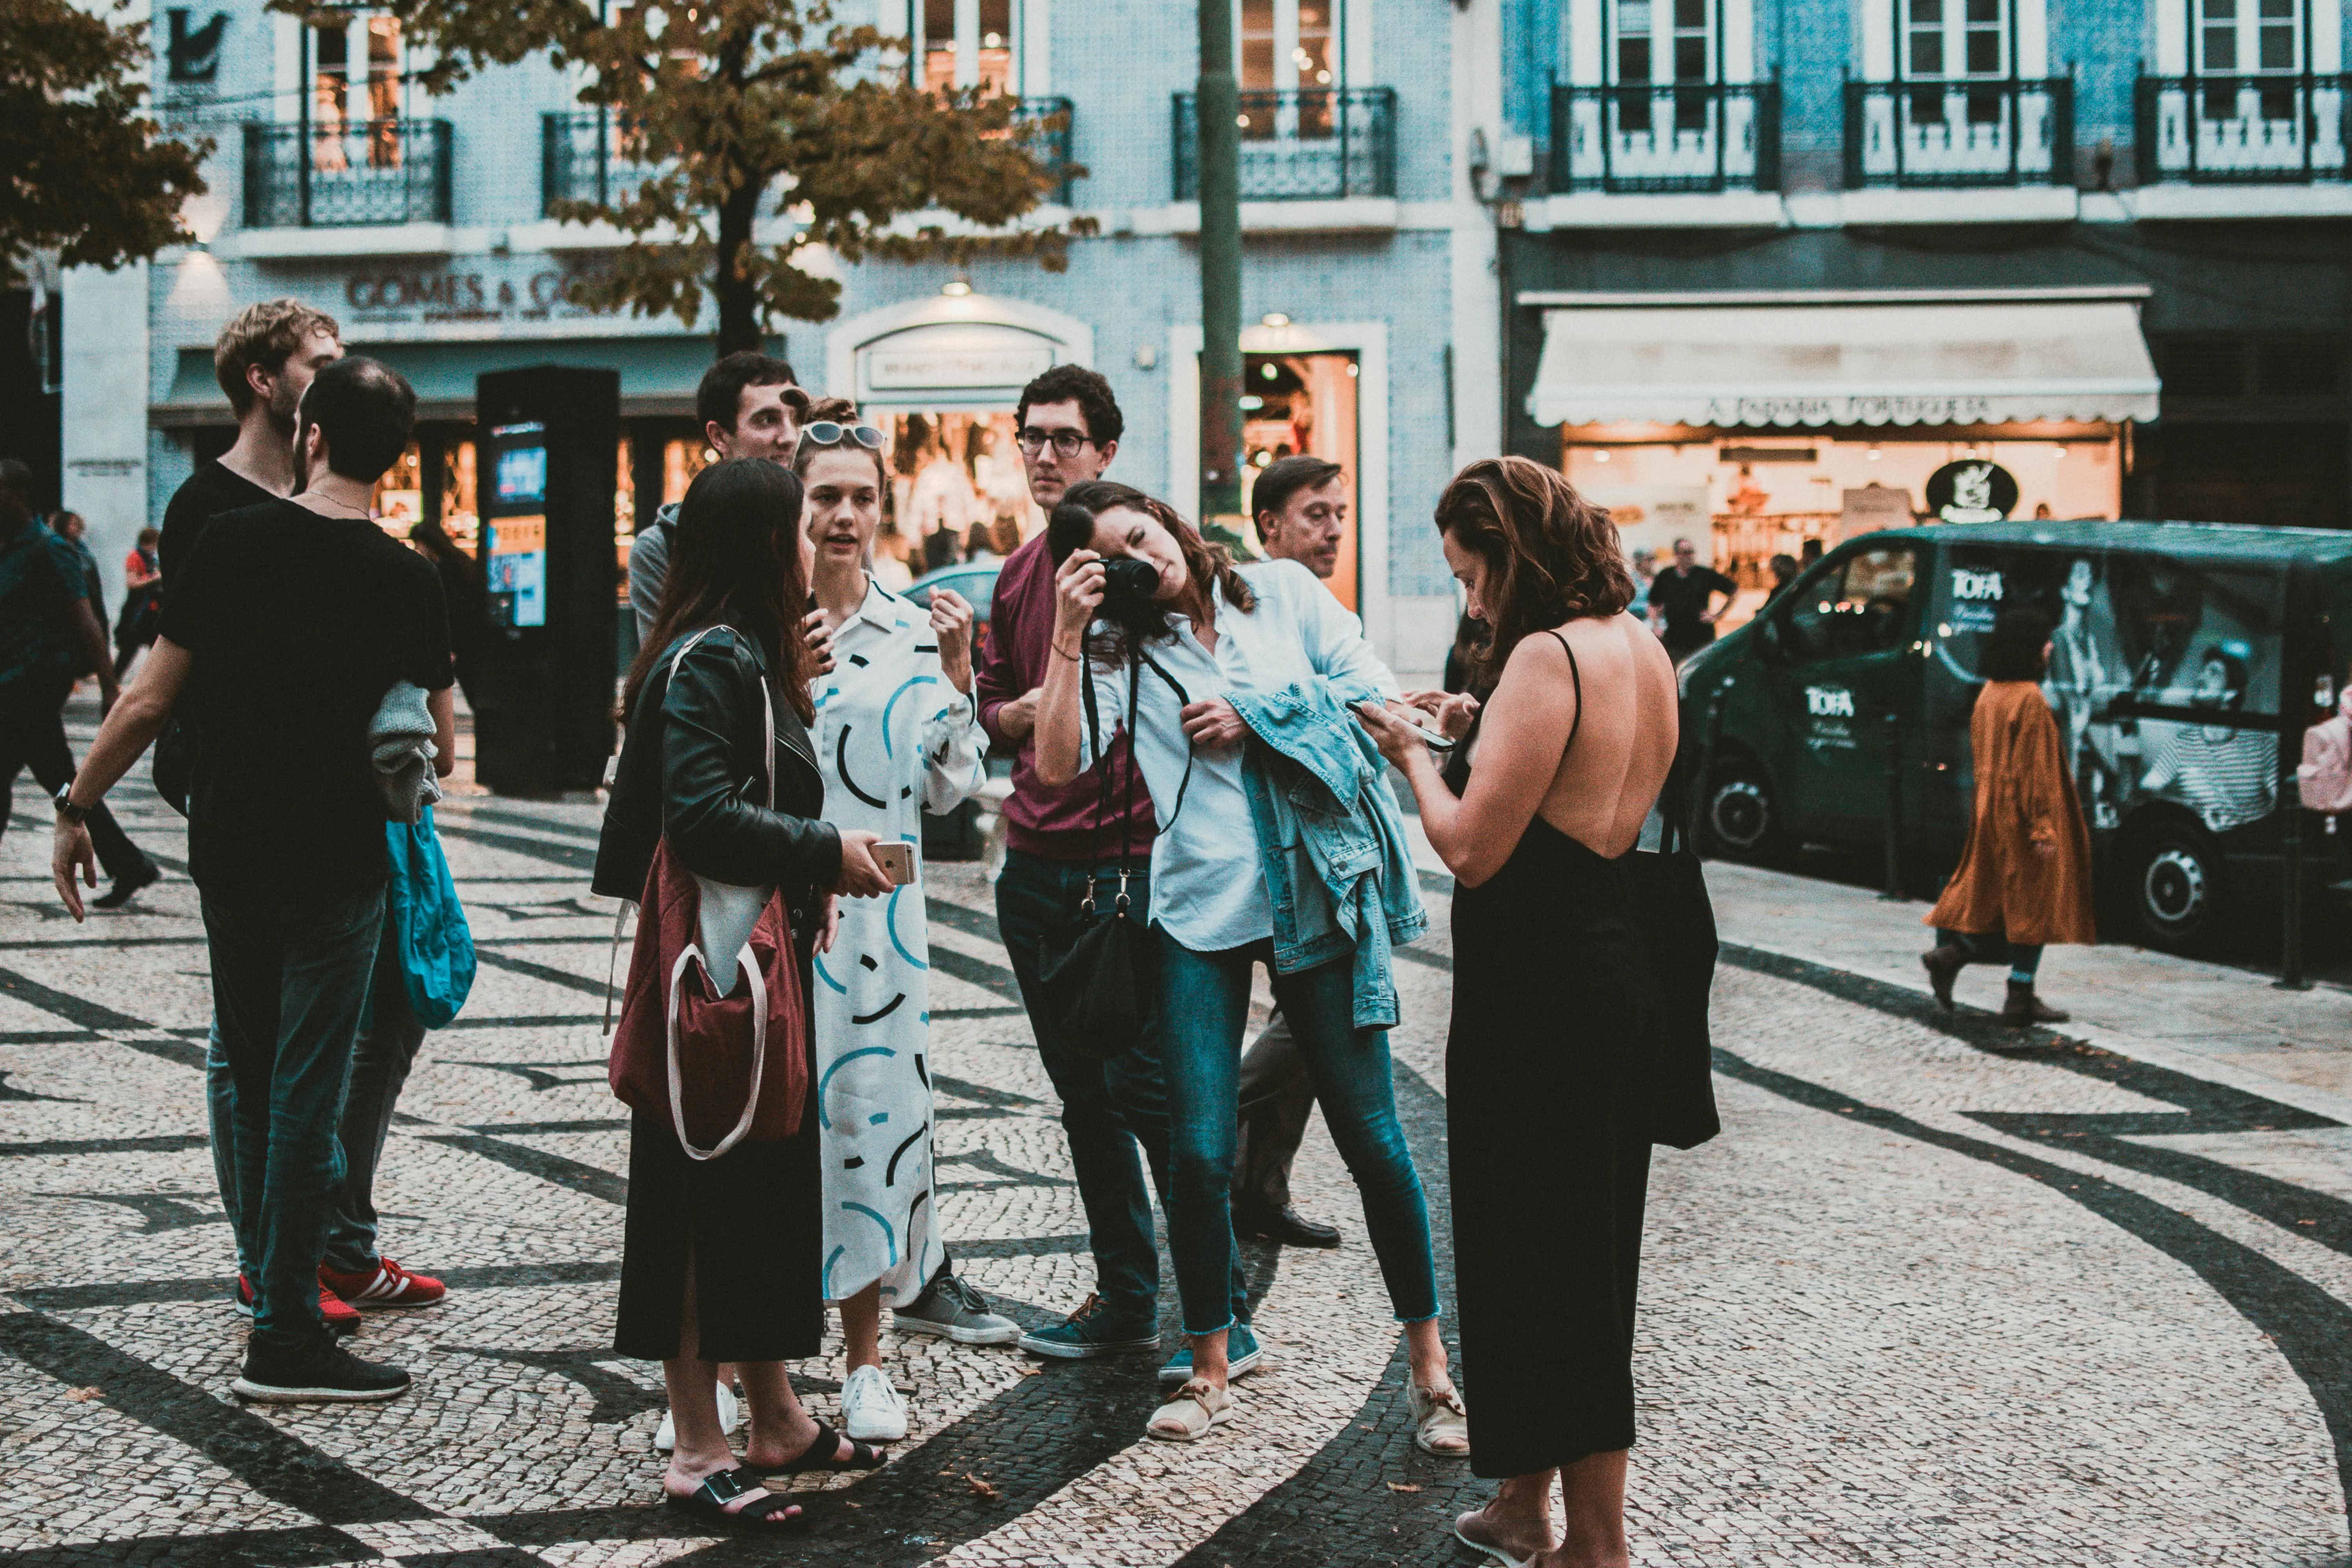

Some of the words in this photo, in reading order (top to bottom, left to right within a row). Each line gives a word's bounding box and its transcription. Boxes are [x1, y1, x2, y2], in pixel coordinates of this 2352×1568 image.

[347, 272, 484, 310] GOMES
[1951, 569, 2003, 601] TOFA
[1805, 686, 1855, 717] TOFA
